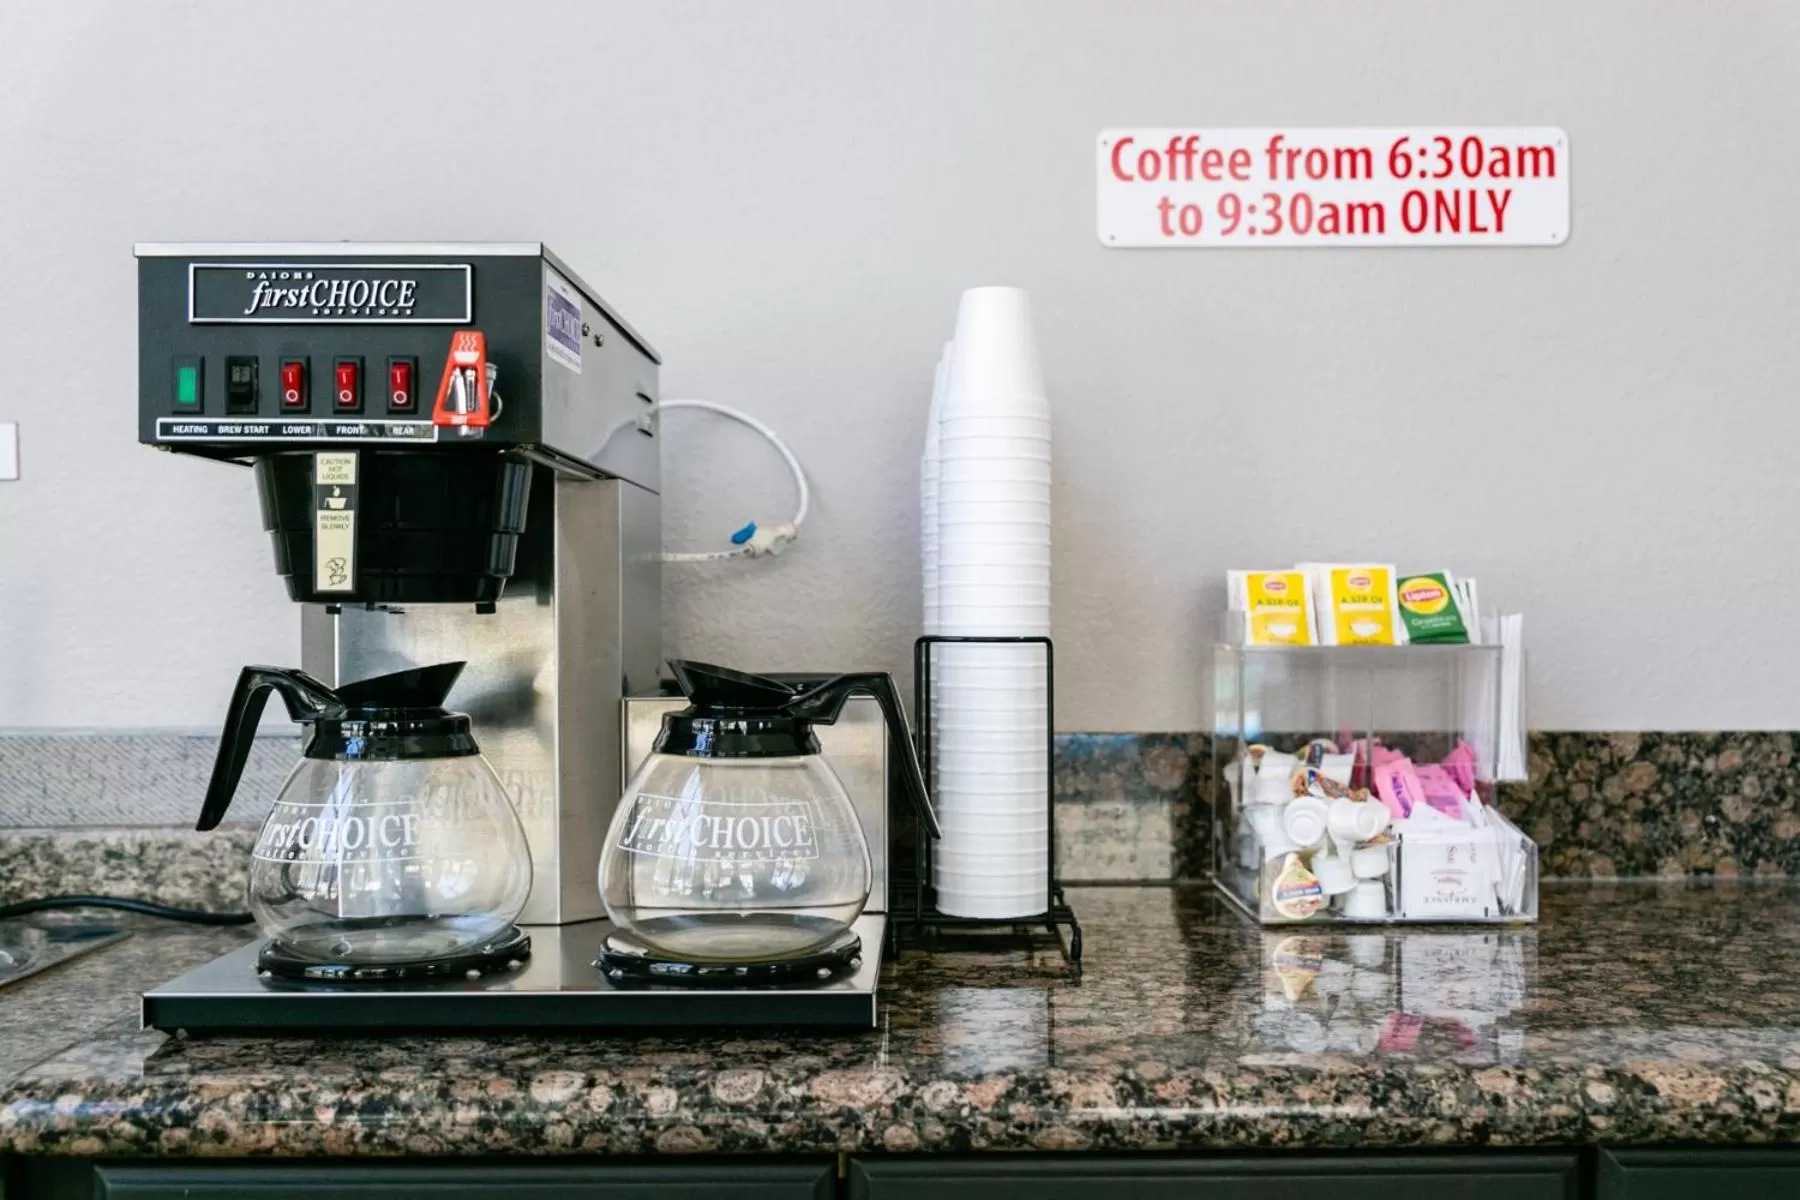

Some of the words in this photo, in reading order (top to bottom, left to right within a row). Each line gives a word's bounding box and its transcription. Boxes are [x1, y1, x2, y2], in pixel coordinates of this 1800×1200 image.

[1110, 135, 1253, 182] Coffee
[1265, 134, 1374, 181] from
[1388, 135, 1556, 179] 6:30am
[1157, 195, 1202, 237] to
[1216, 191, 1386, 236] 9:30am
[1401, 188, 1512, 234] ONLY
[172, 424, 208, 433] HEATING
[218, 425, 243, 433] BREW
[243, 425, 270, 434] START
[282, 425, 312, 434] LOWER
[336, 425, 364, 434] FRONT
[392, 426, 415, 435] REAR
